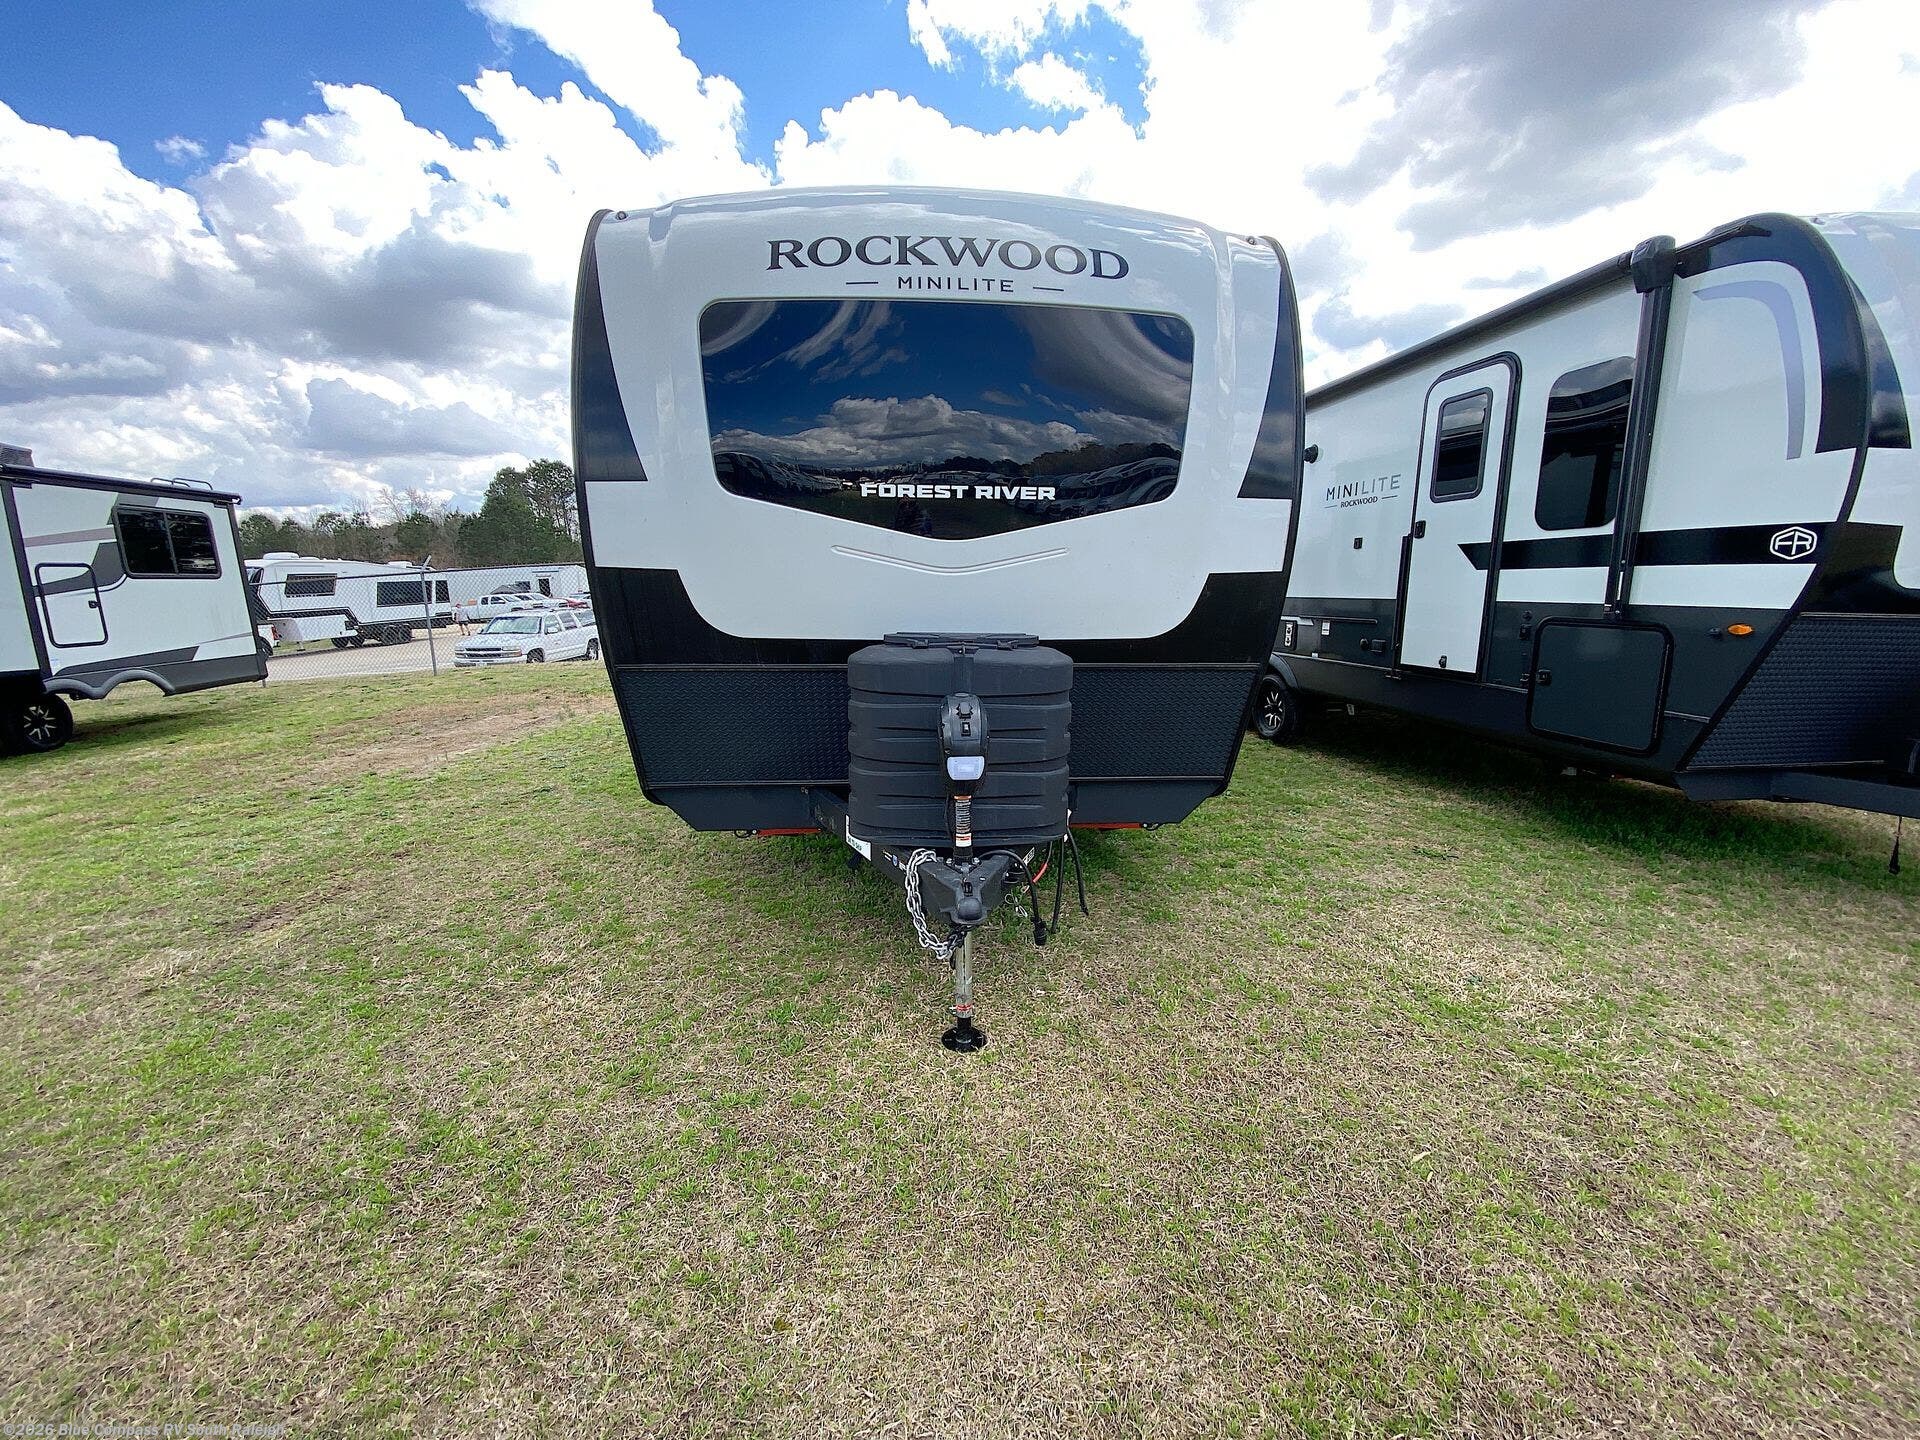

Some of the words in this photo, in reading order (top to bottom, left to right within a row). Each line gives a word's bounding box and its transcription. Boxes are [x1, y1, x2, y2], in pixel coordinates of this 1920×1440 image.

[766, 235, 1129, 280] ROCKWOOD
[898, 276, 1014, 293] MINILITE
[860, 483, 969, 499] FOREST
[974, 485, 1056, 500] RIVER
[1326, 473, 1401, 501] MINILITE
[1340, 496, 1379, 508] ROCKWOOD
